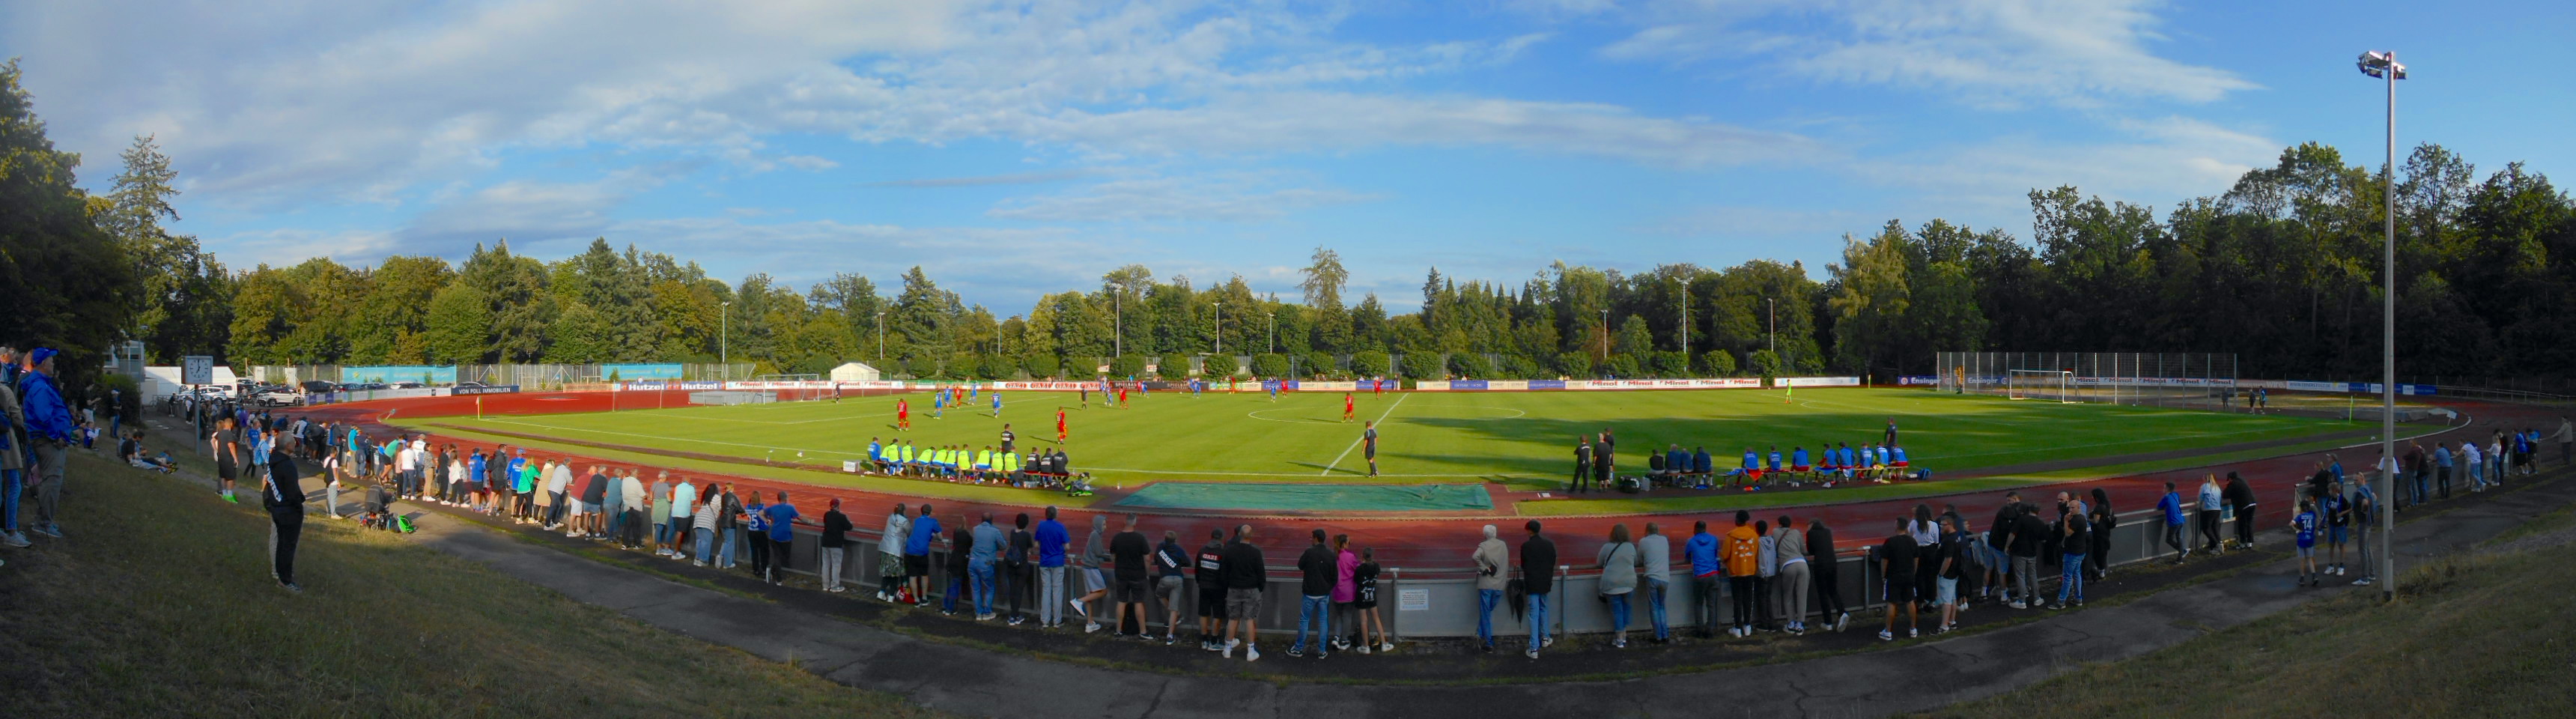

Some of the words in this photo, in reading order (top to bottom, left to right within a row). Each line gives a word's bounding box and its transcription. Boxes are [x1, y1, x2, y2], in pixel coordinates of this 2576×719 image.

[1968, 377, 1998, 385] Ensinger
[2302, 519, 2313, 530] 14
[1158, 550, 1176, 568] KICKERS
